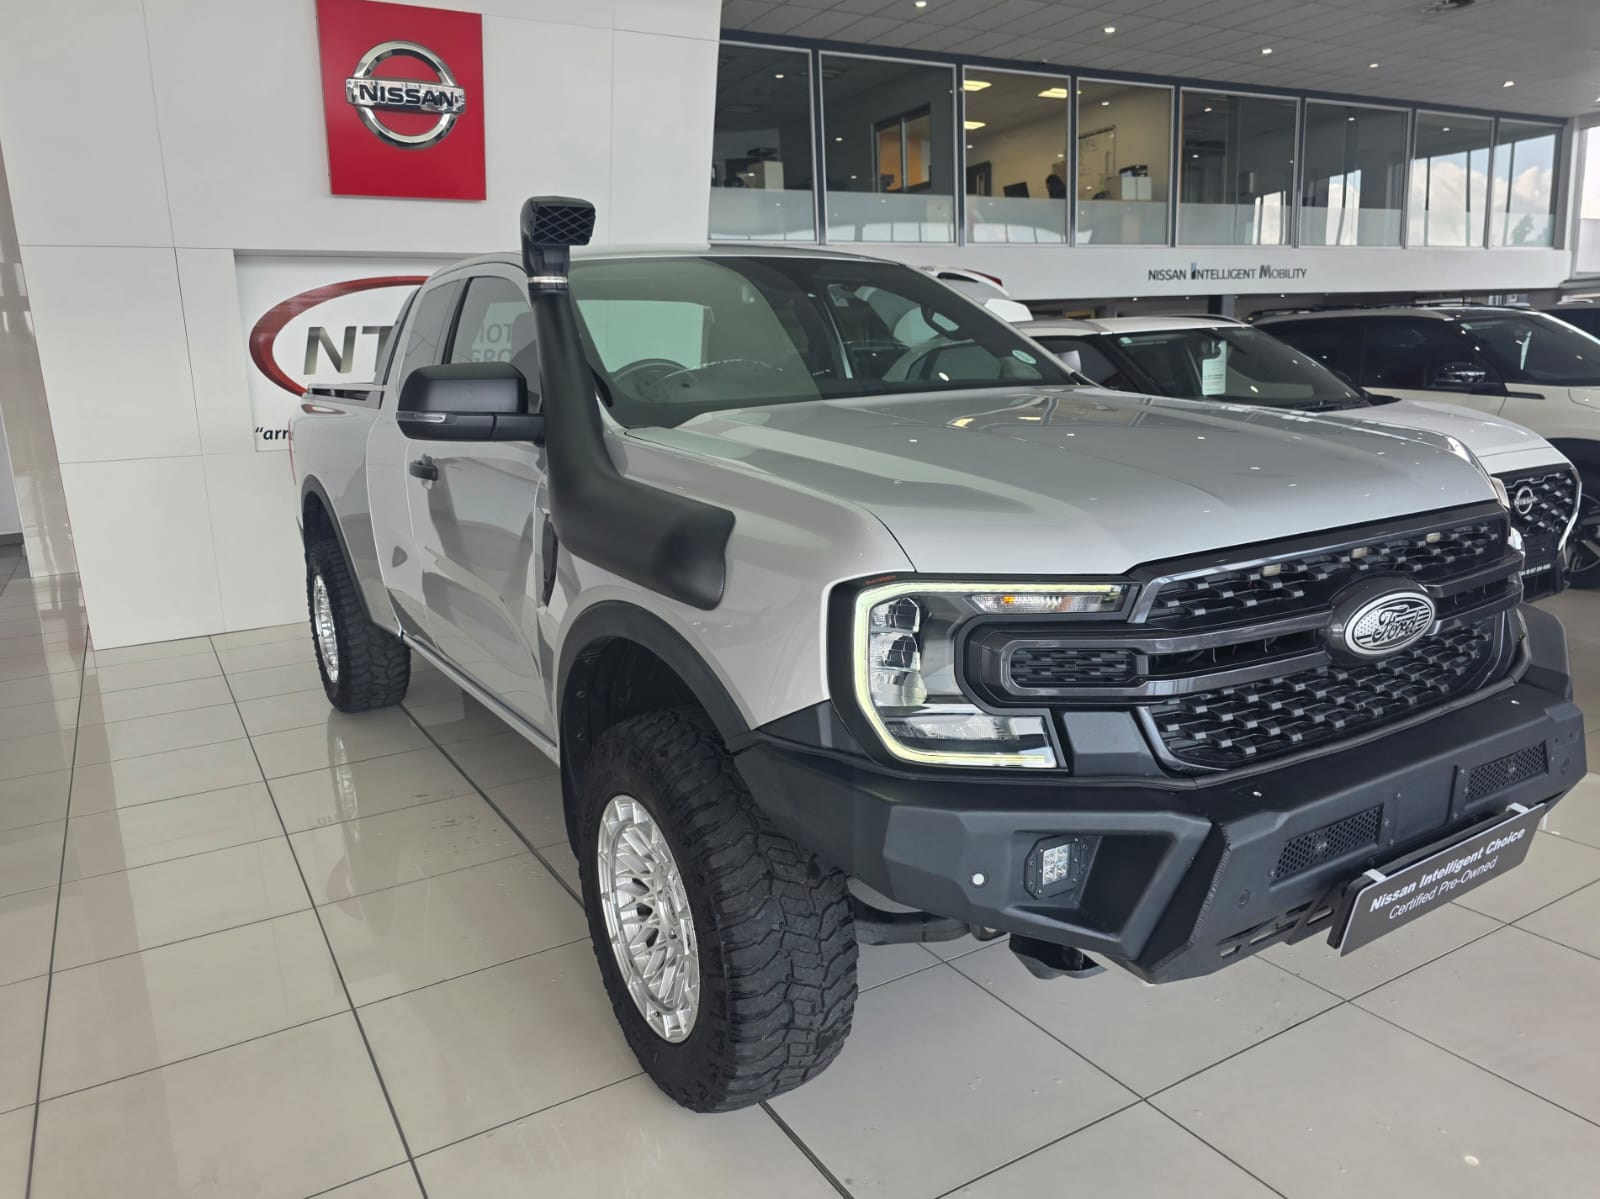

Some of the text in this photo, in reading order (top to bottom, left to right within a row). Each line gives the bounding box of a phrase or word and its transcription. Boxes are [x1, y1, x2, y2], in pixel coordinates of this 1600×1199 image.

[359, 84, 454, 107] NISSAN
[1148, 262, 1307, 281] NISSAN INTELLIGENT MOBILITY
[1372, 604, 1419, 643] Ford
[1369, 828, 1526, 912] Nissan Intelligent Choice
[1388, 855, 1499, 919] Certified Pre-Owned
